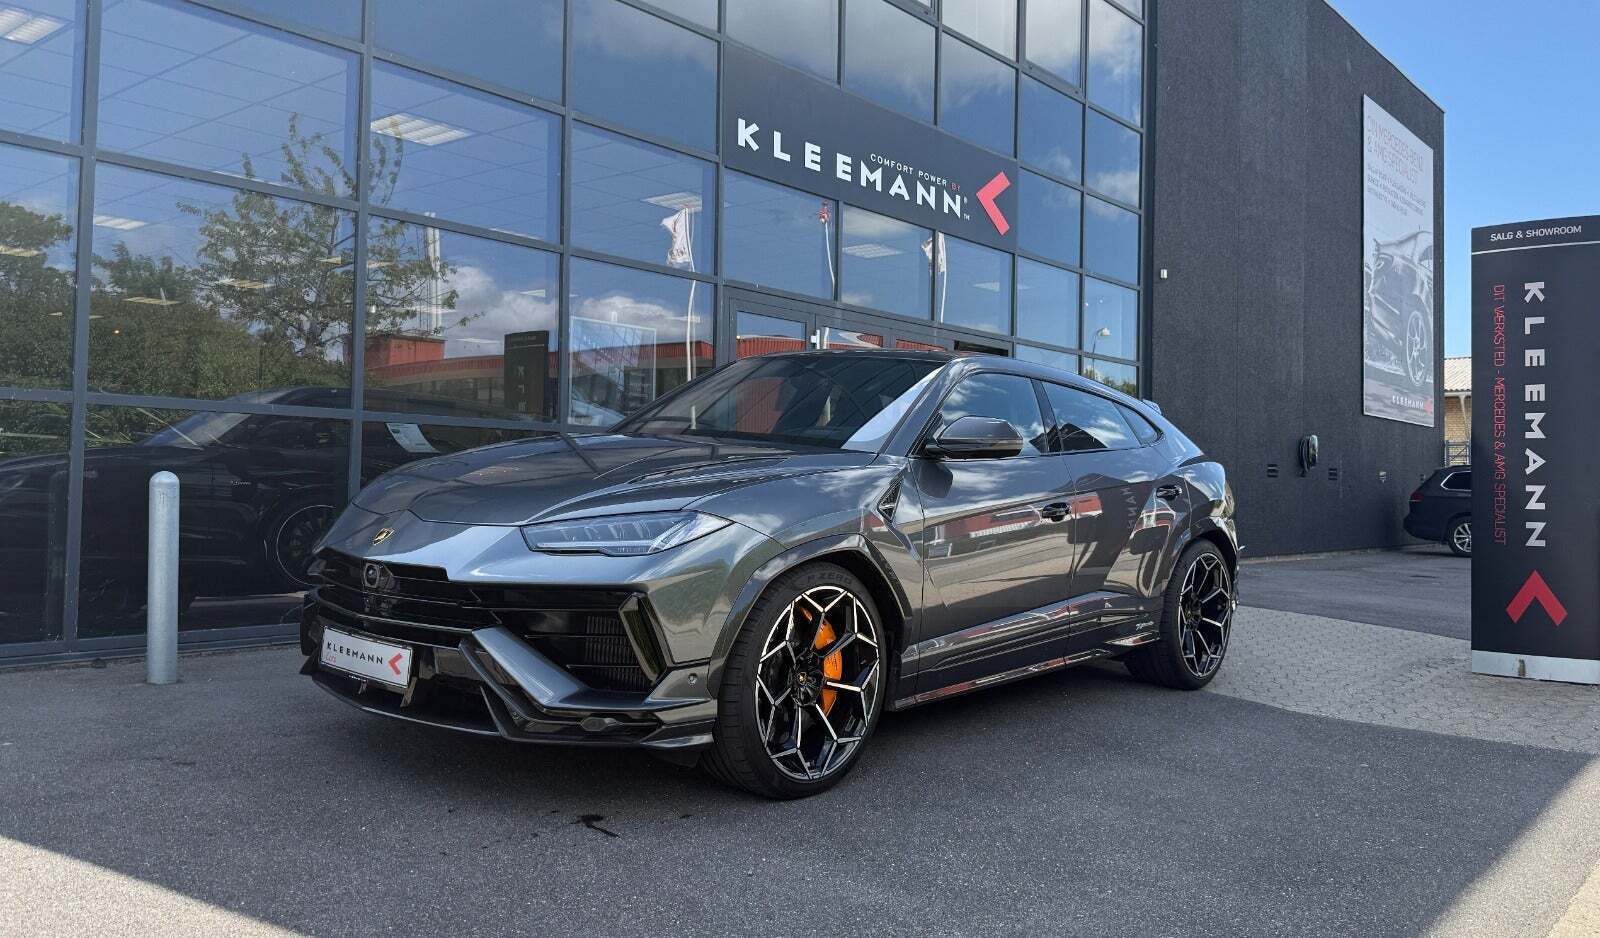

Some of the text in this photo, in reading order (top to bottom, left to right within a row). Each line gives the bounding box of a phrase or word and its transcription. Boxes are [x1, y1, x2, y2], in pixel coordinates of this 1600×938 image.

[737, 118, 961, 218] KLEEMANN
[870, 153, 913, 175] COMFORT
[918, 170, 948, 187] POWER
[1490, 225, 1582, 242] SALG & SHOWROOM
[1493, 284, 1505, 303] DIT
[1493, 377, 1506, 438] MERCEDES
[1524, 281, 1547, 547] KLEEMANN
[1494, 441, 1506, 449] &
[1494, 453, 1506, 480] AMG
[1494, 484, 1507, 545] SPECIALIST
[327, 641, 383, 665] KLEEMANN
